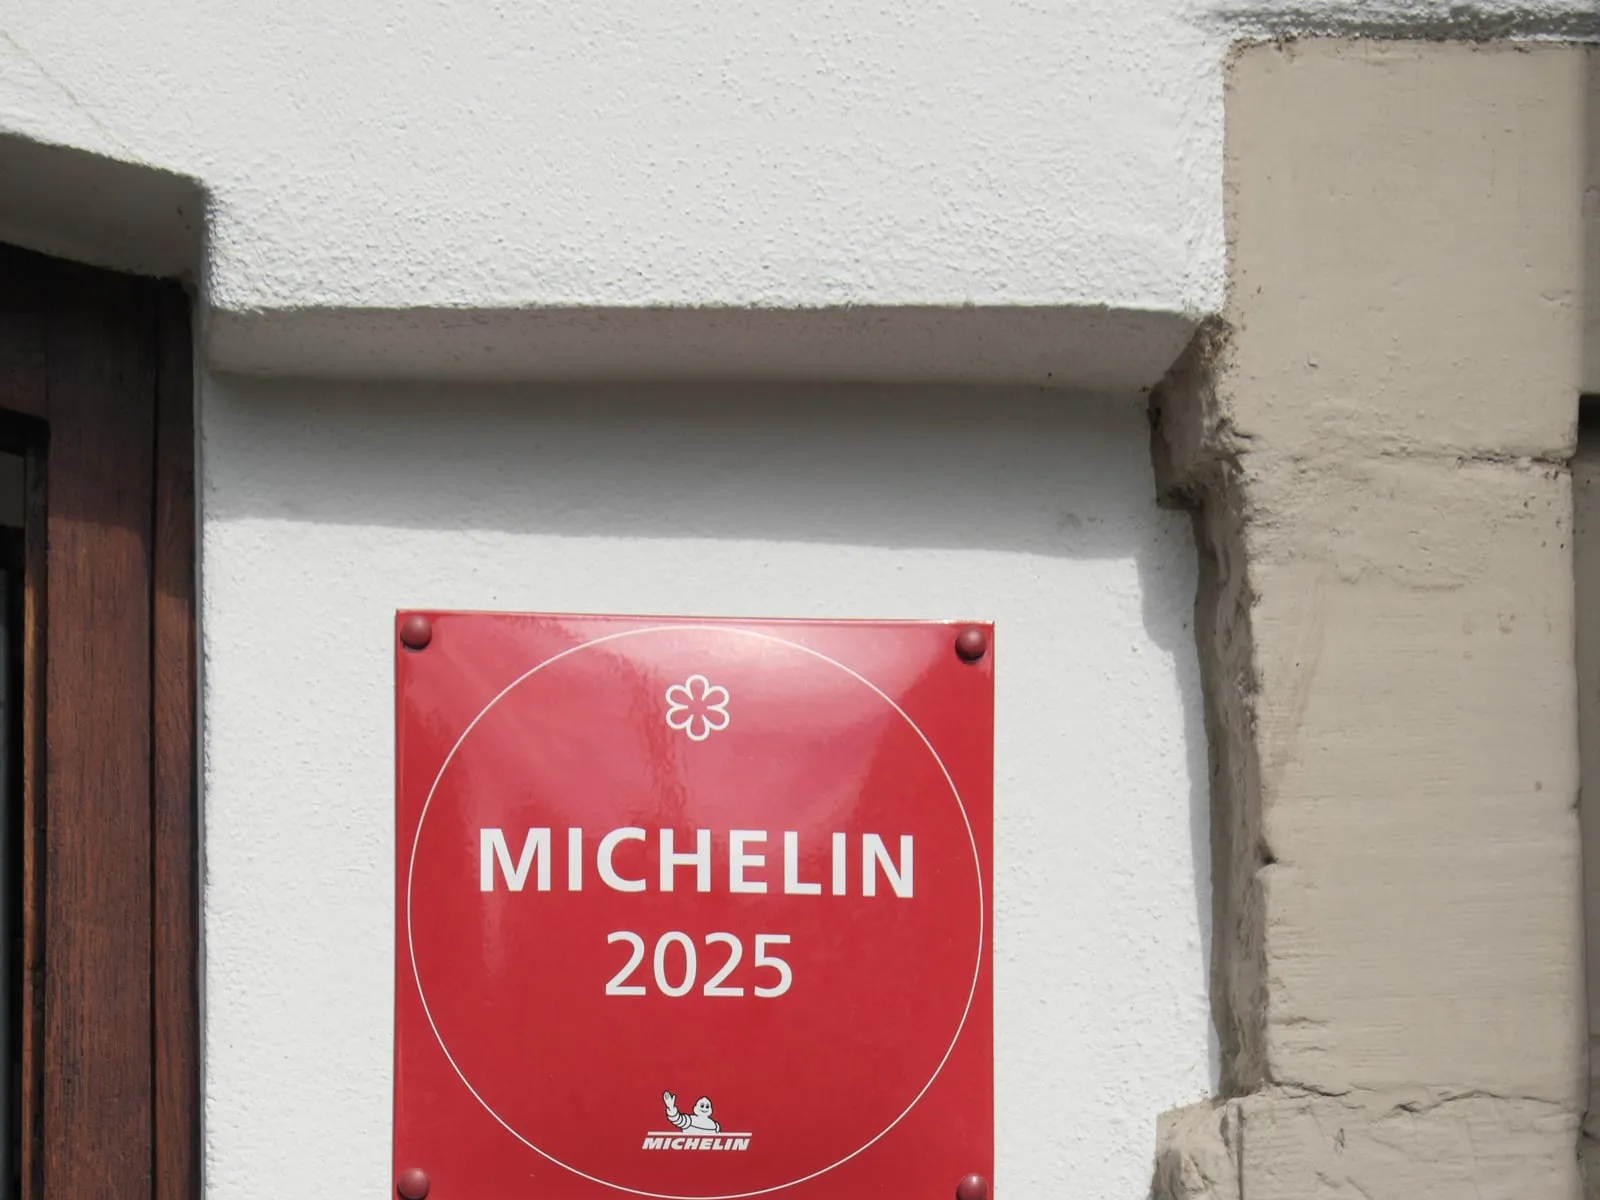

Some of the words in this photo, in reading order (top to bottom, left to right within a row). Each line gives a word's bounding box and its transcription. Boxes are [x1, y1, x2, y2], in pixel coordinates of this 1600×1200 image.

[479, 827, 914, 898] MICHELIN
[605, 931, 793, 998] 2025
[641, 1137, 751, 1151] MICHELIN
